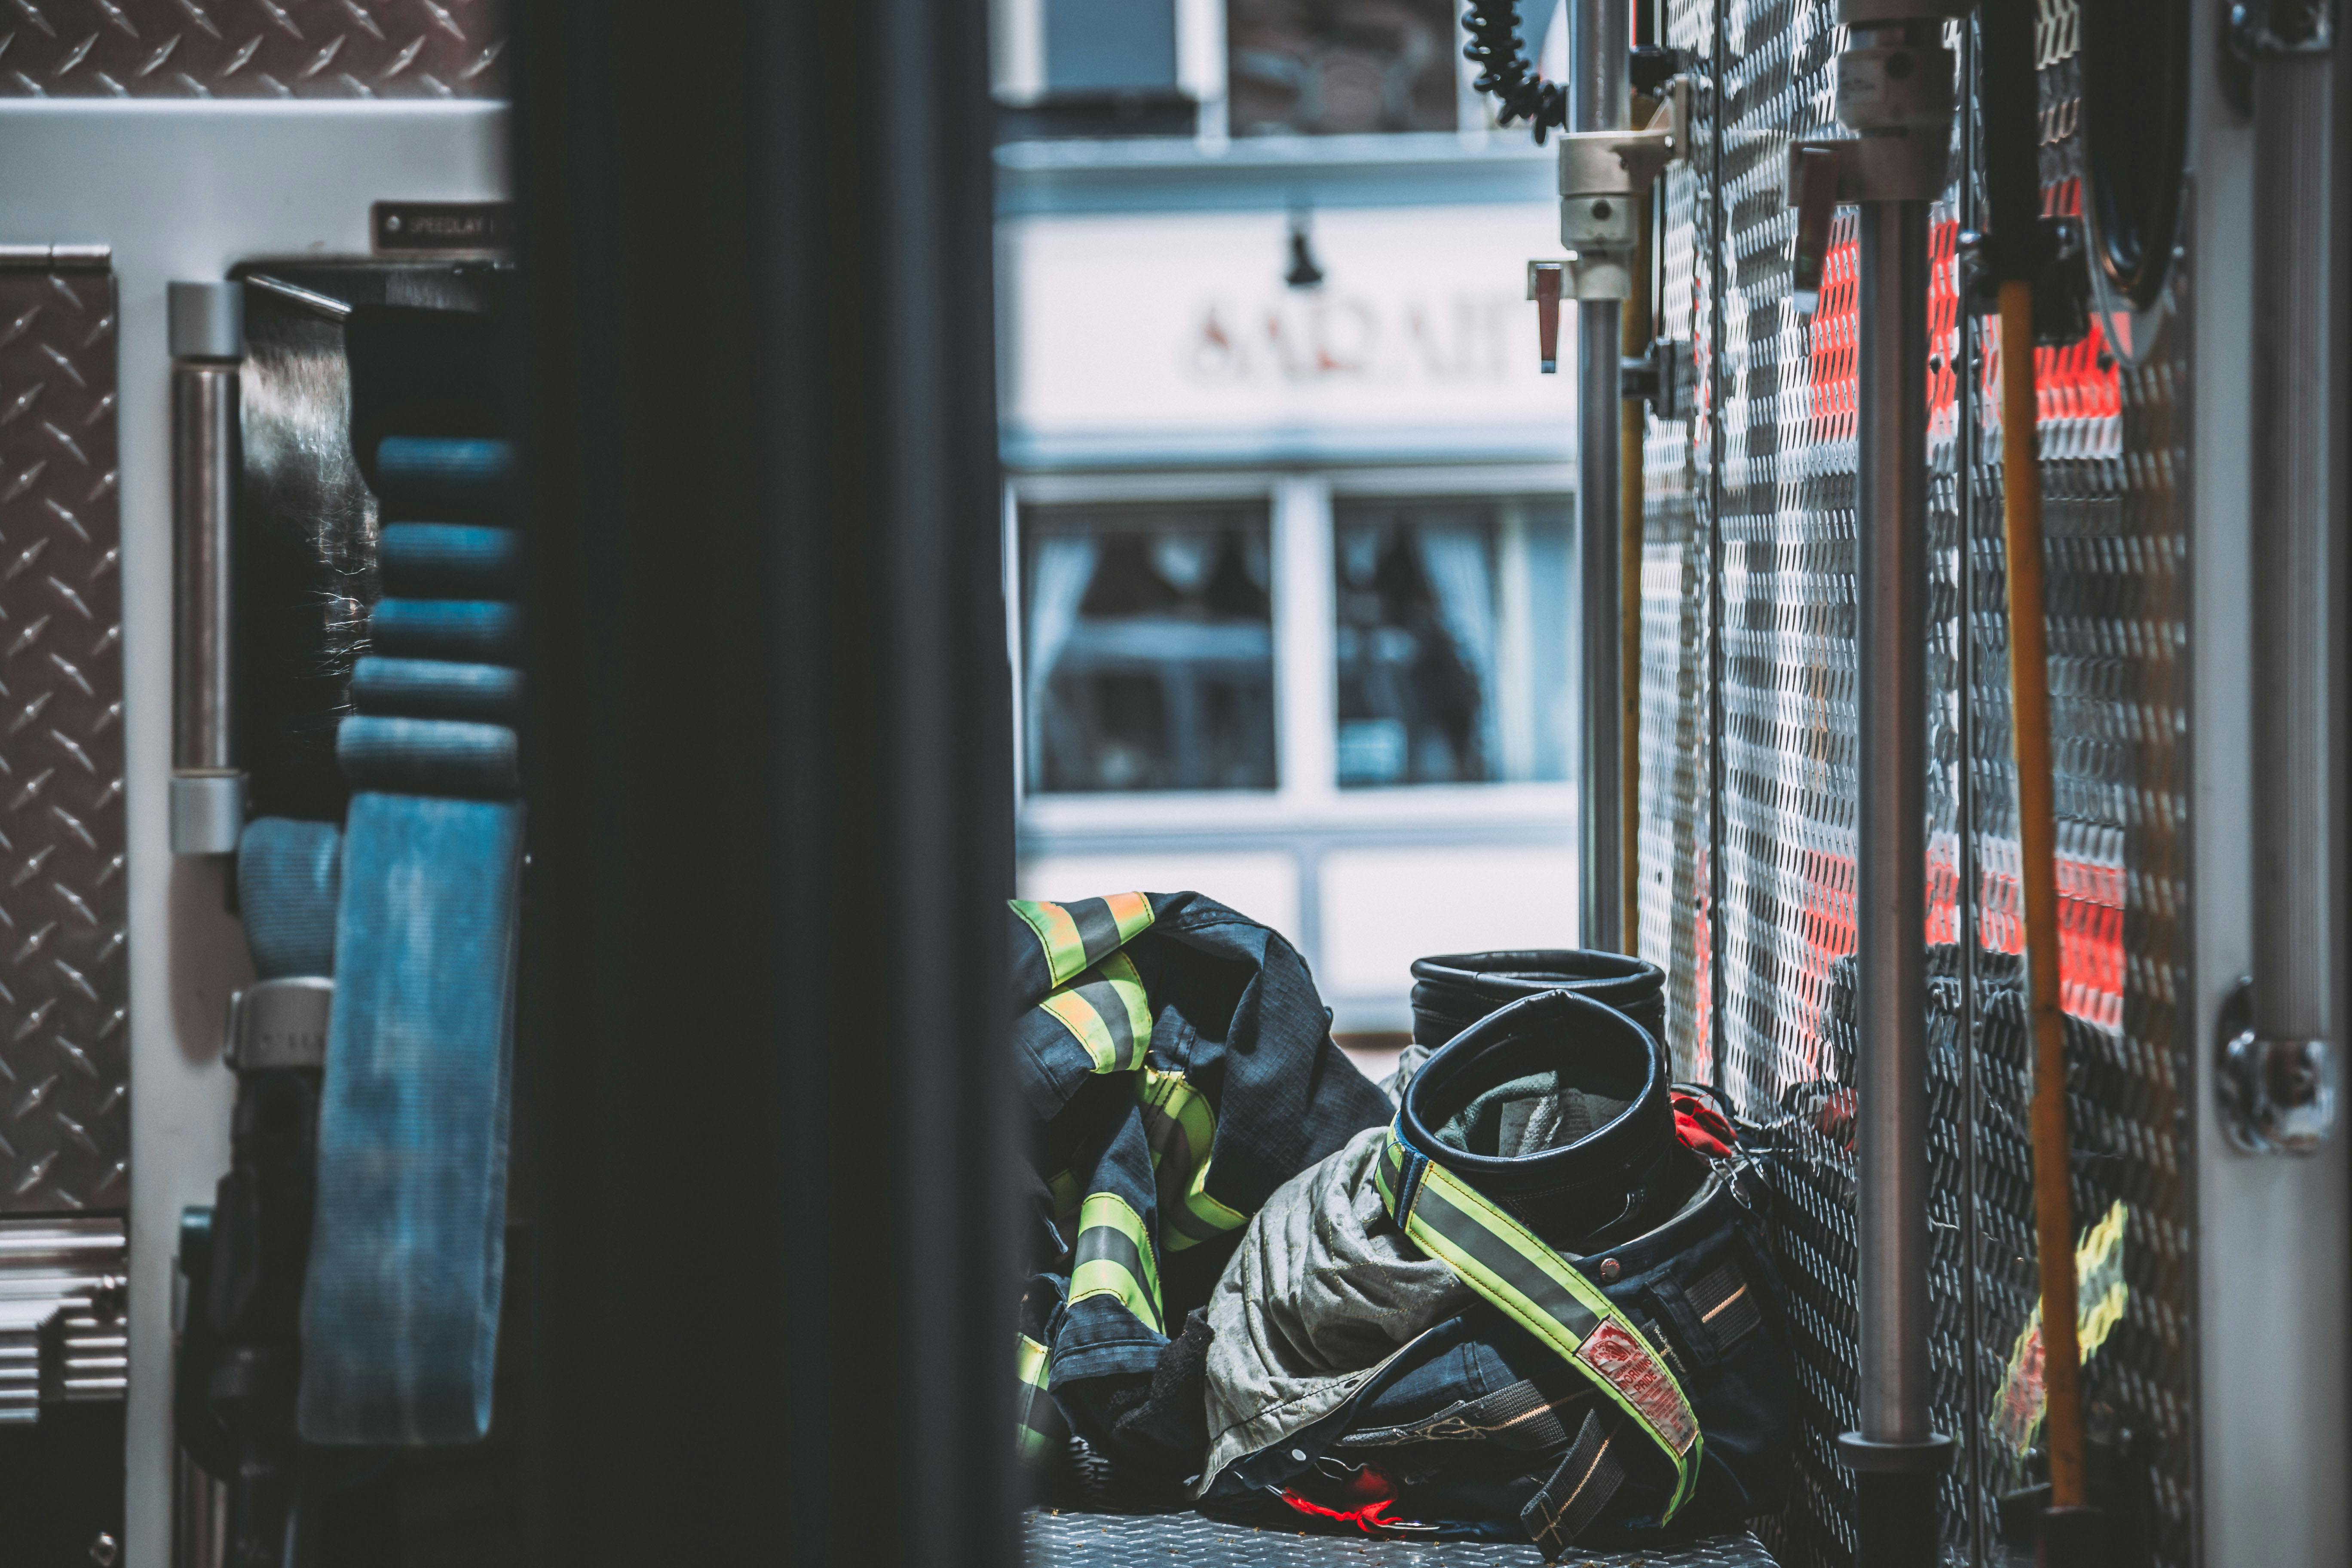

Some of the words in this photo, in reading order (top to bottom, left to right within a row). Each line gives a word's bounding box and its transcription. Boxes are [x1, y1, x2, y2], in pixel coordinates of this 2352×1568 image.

[1615, 1365, 1627, 1378] GEAR
[1632, 1351, 1642, 1361] WITH
[1617, 1355, 1652, 1390] MORNING
[1633, 1369, 1657, 1394] PRIDE
